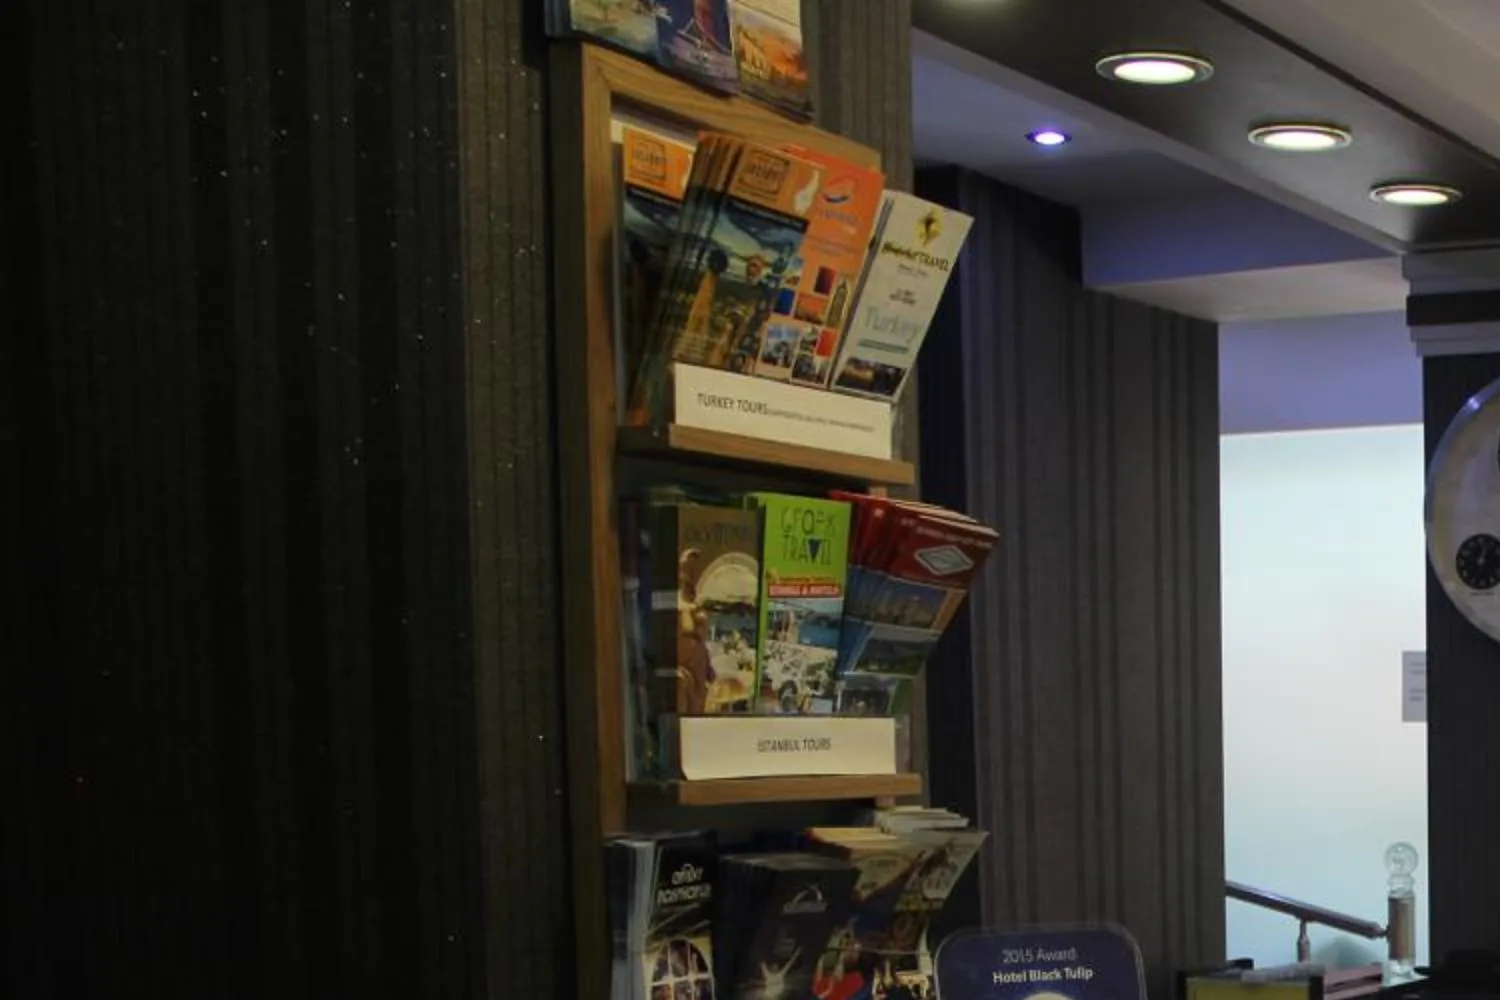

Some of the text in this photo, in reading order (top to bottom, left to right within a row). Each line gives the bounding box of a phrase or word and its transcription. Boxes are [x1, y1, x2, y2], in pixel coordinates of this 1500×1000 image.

[697, 392, 768, 416] TURKEY TOURS
[757, 737, 831, 753] ISTANBUL TOURS
[1003, 947, 1077, 964] 2015 Award
[993, 966, 1094, 984] Hotel Black Tulip
